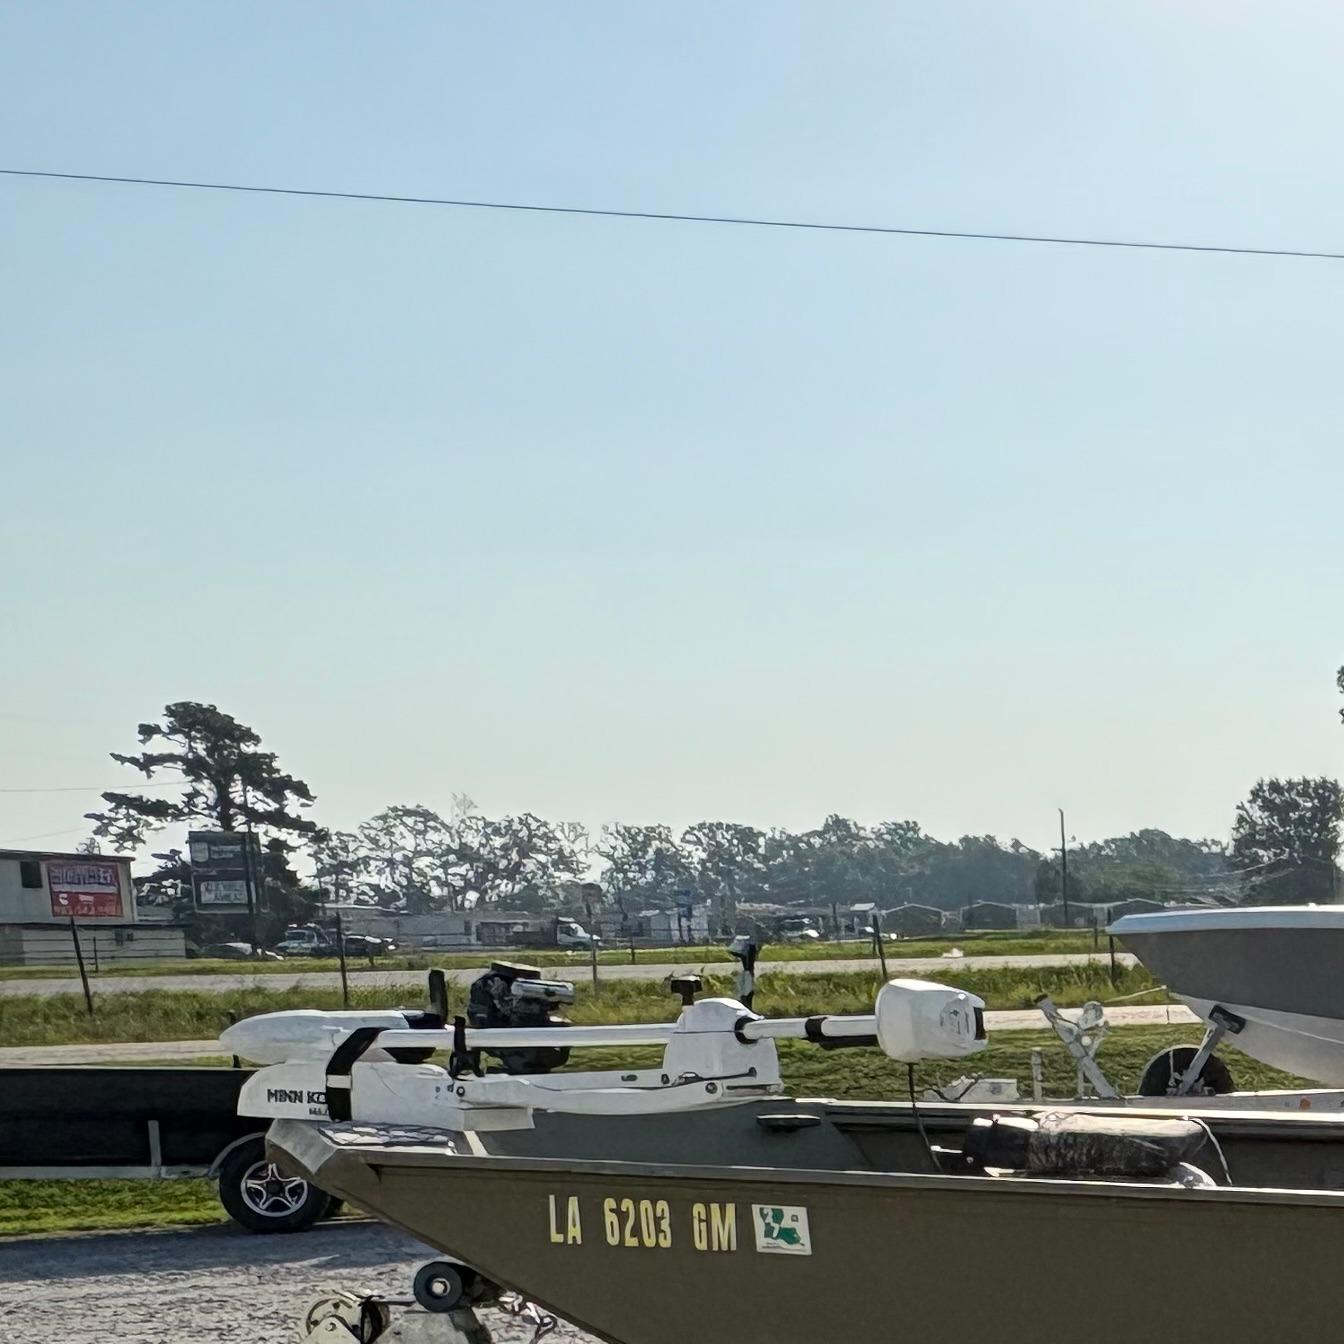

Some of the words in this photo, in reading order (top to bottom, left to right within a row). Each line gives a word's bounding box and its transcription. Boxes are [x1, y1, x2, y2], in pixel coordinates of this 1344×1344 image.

[267, 1089, 303, 1103] MINN
[549, 1194, 582, 1245] LA
[603, 1198, 672, 1248] 6203
[692, 1203, 737, 1251] GM
